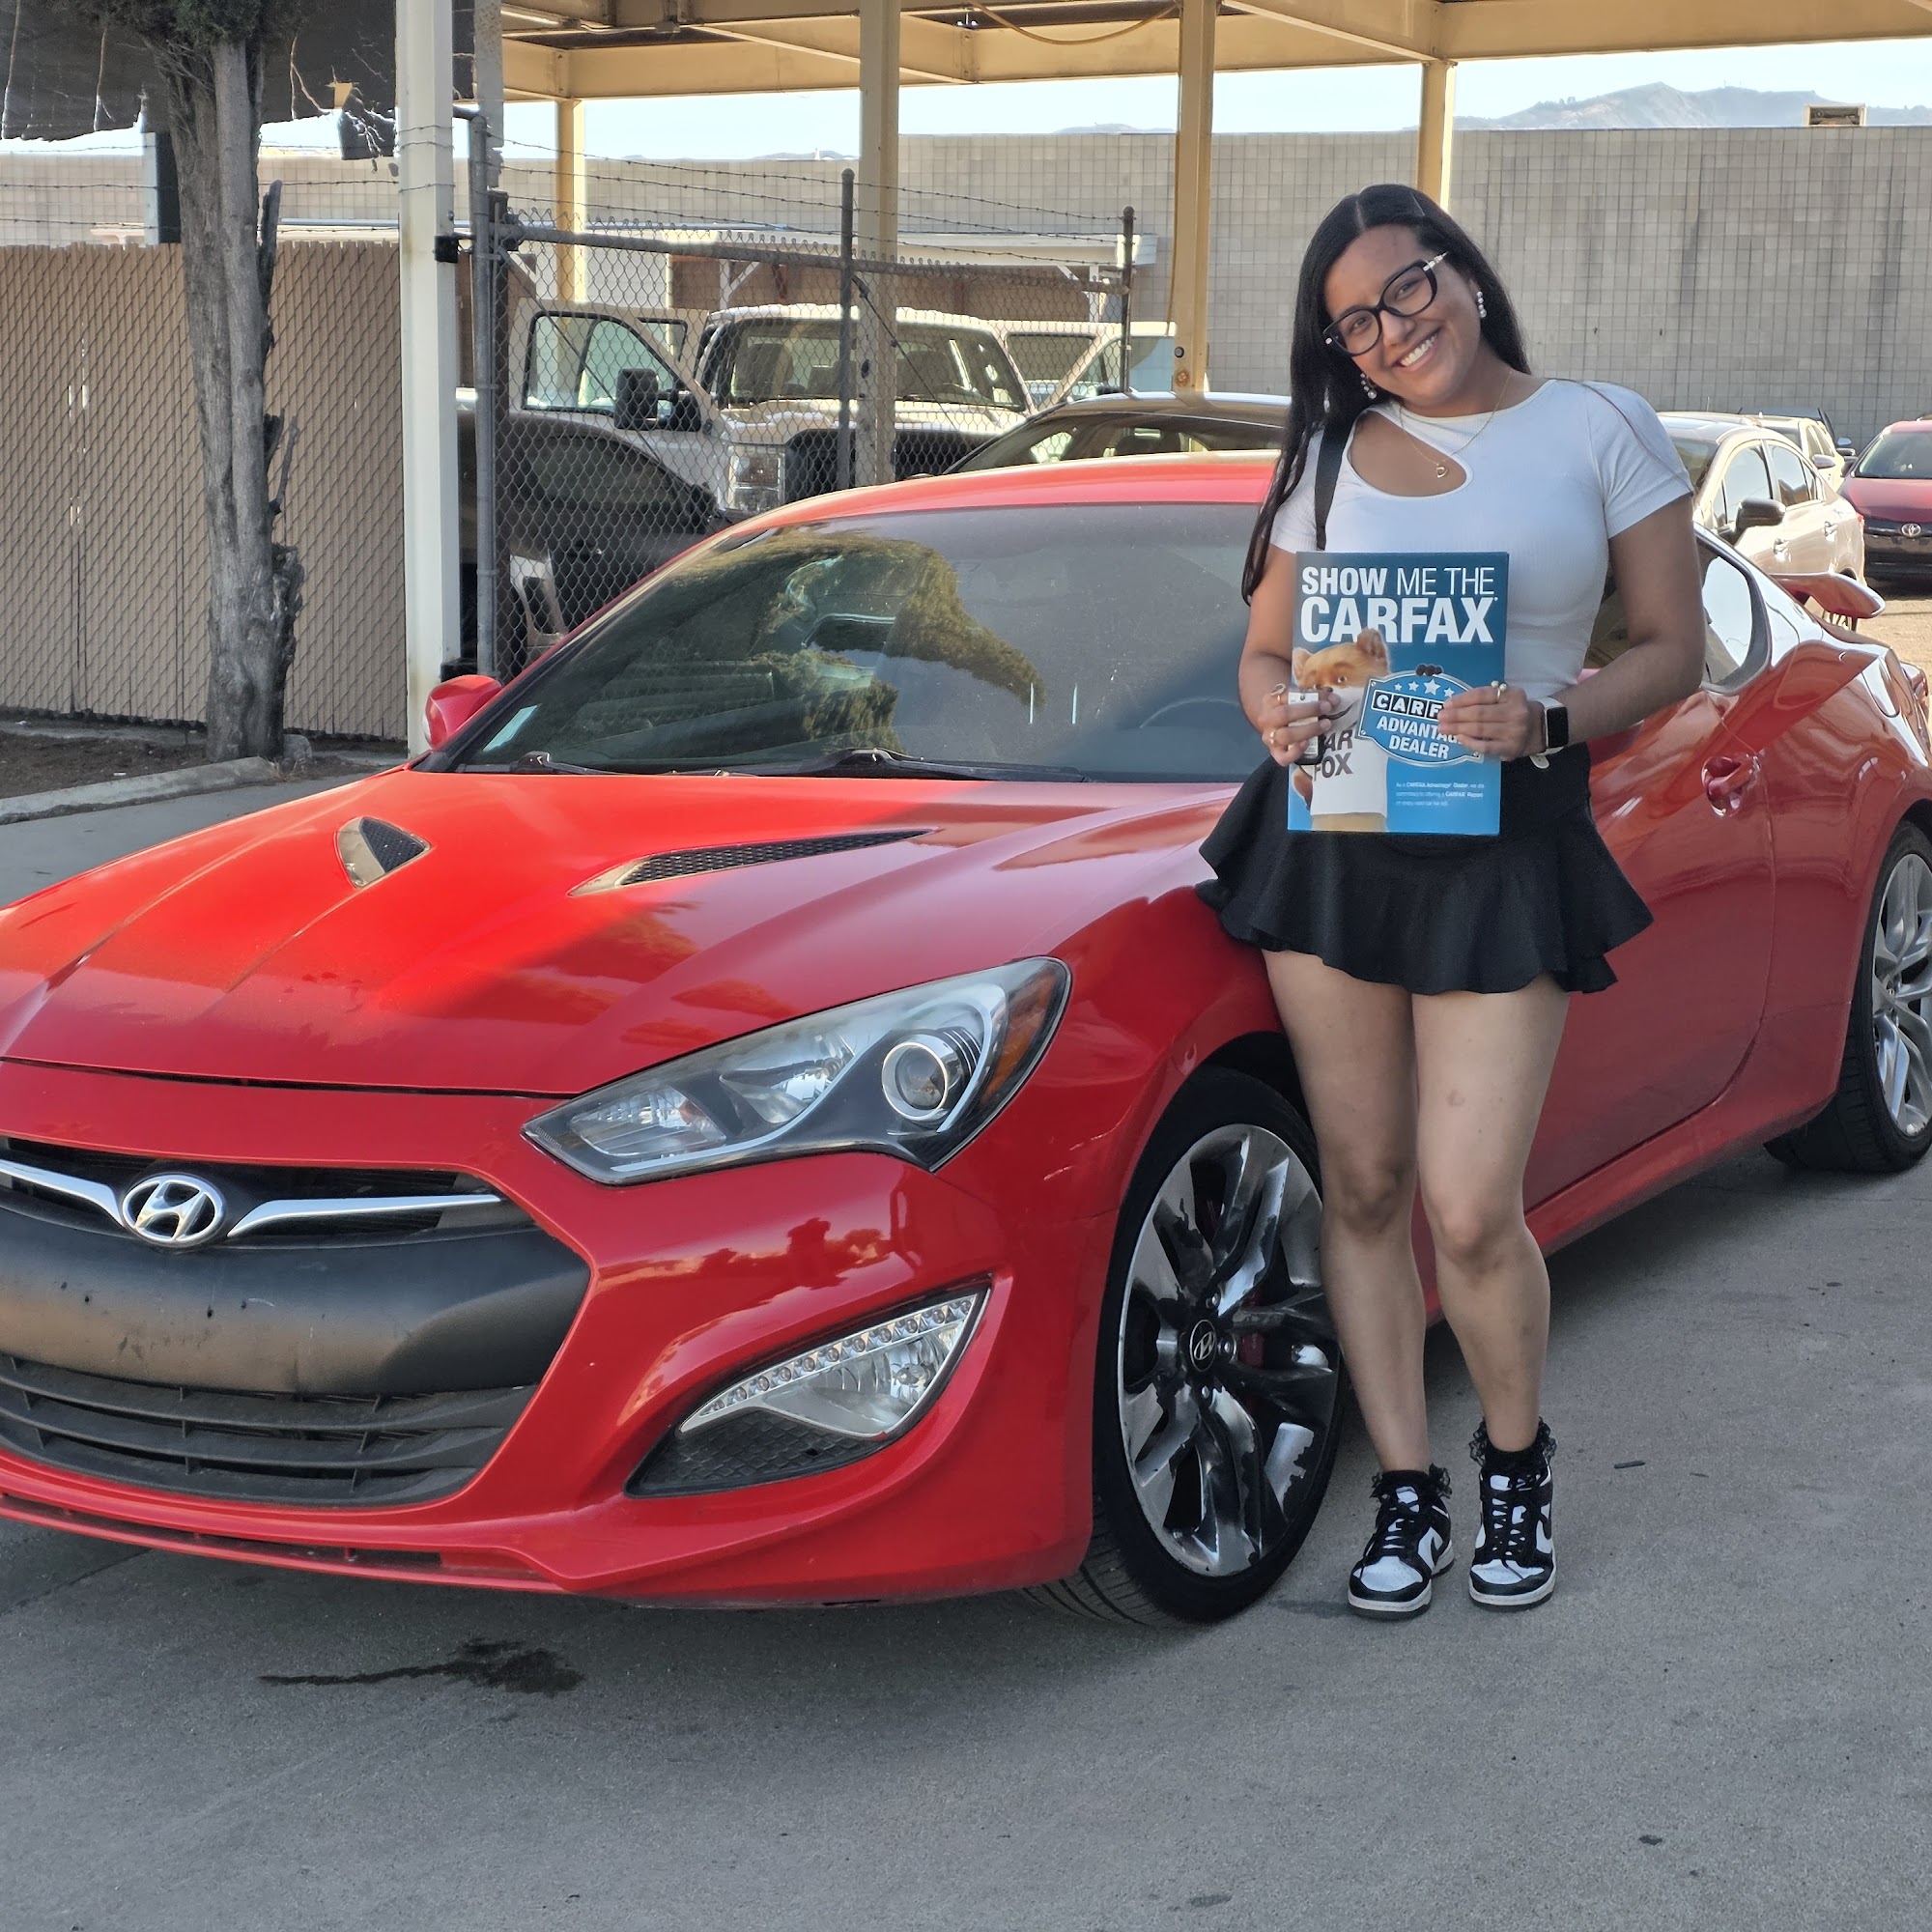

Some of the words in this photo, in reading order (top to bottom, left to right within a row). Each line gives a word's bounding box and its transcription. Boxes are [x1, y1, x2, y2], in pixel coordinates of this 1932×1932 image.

[1302, 567, 1387, 596] SHOW
[1397, 568, 1437, 596] ME
[1444, 567, 1495, 595] THE
[1300, 596, 1494, 643] CARFAX
[1376, 694, 1443, 718] CARF
[1323, 729, 1353, 753] AR
[1388, 734, 1450, 760] DEALER
